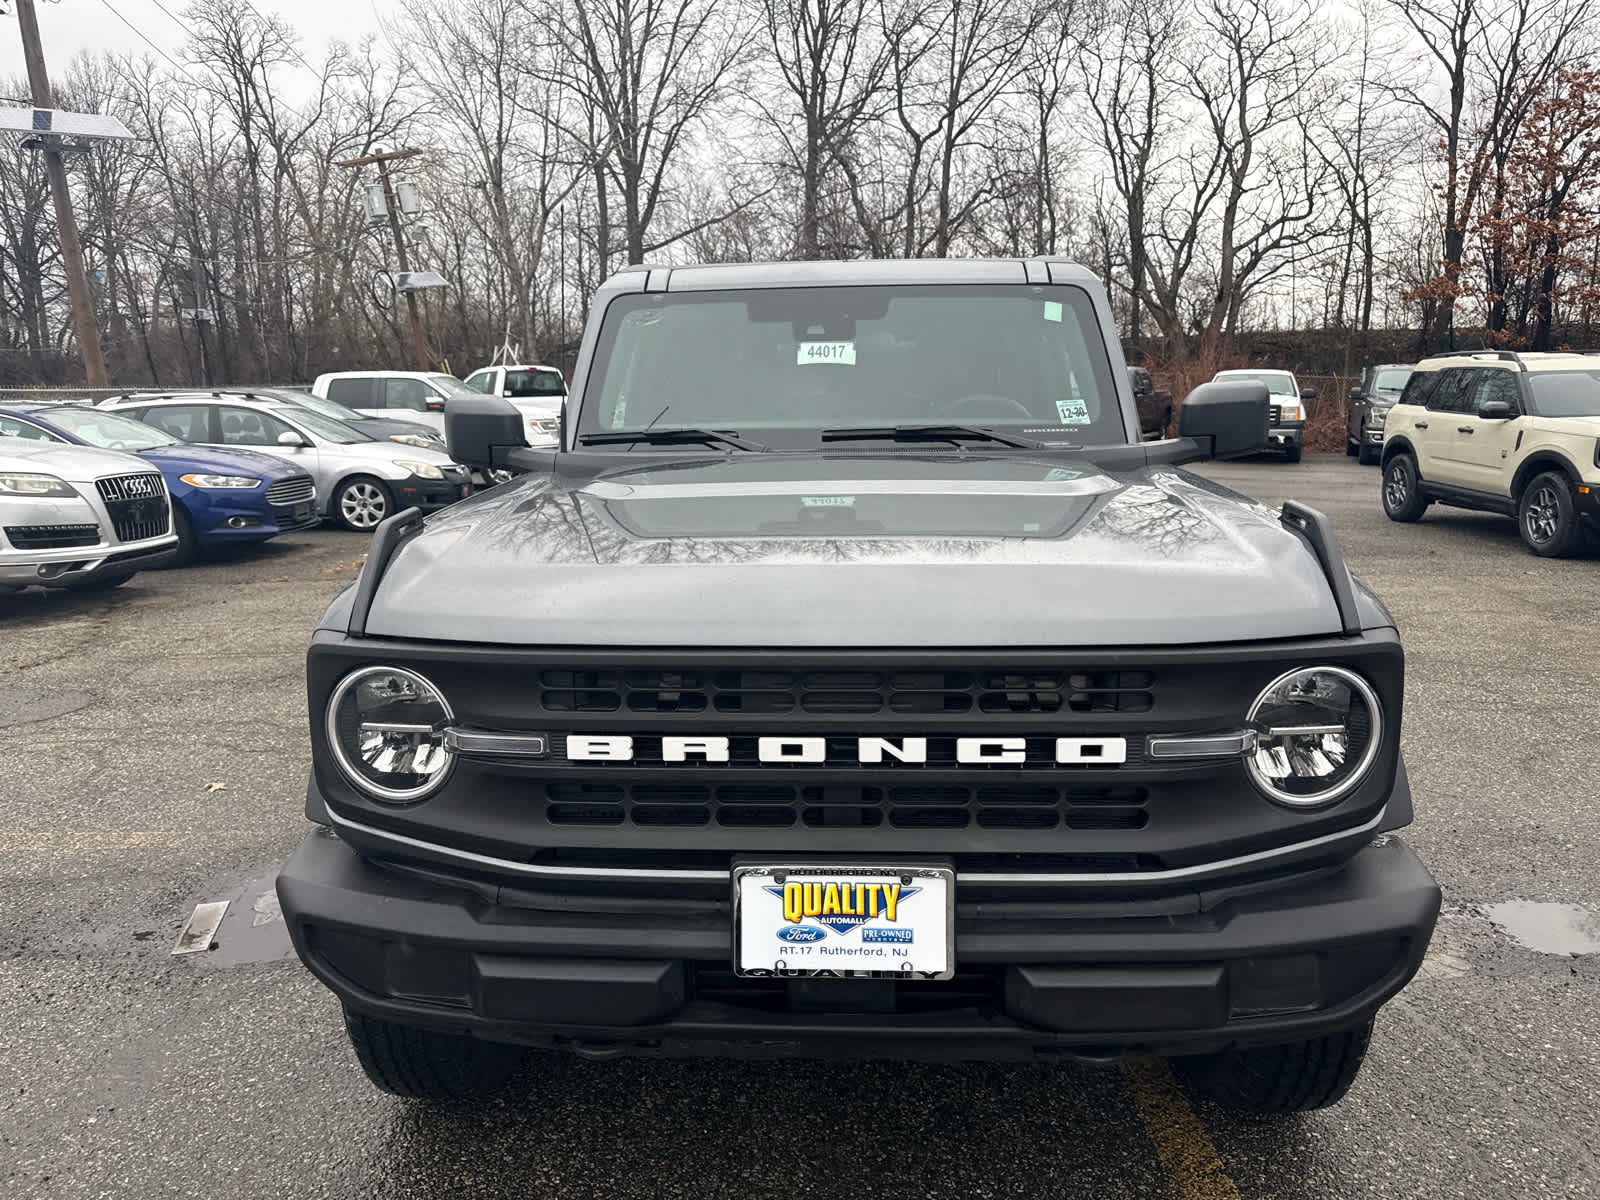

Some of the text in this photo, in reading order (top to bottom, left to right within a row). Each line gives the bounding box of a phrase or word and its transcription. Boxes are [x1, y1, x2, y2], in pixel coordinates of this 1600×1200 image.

[807, 345, 845, 358] 44017
[566, 735, 1126, 763] BRONCO
[783, 881, 901, 923] QUALITY
[820, 917, 865, 925] AUTOMALL
[863, 930, 912, 940] PRE-OWNED
[780, 946, 908, 957] RT.17 Rutherford, NJ
